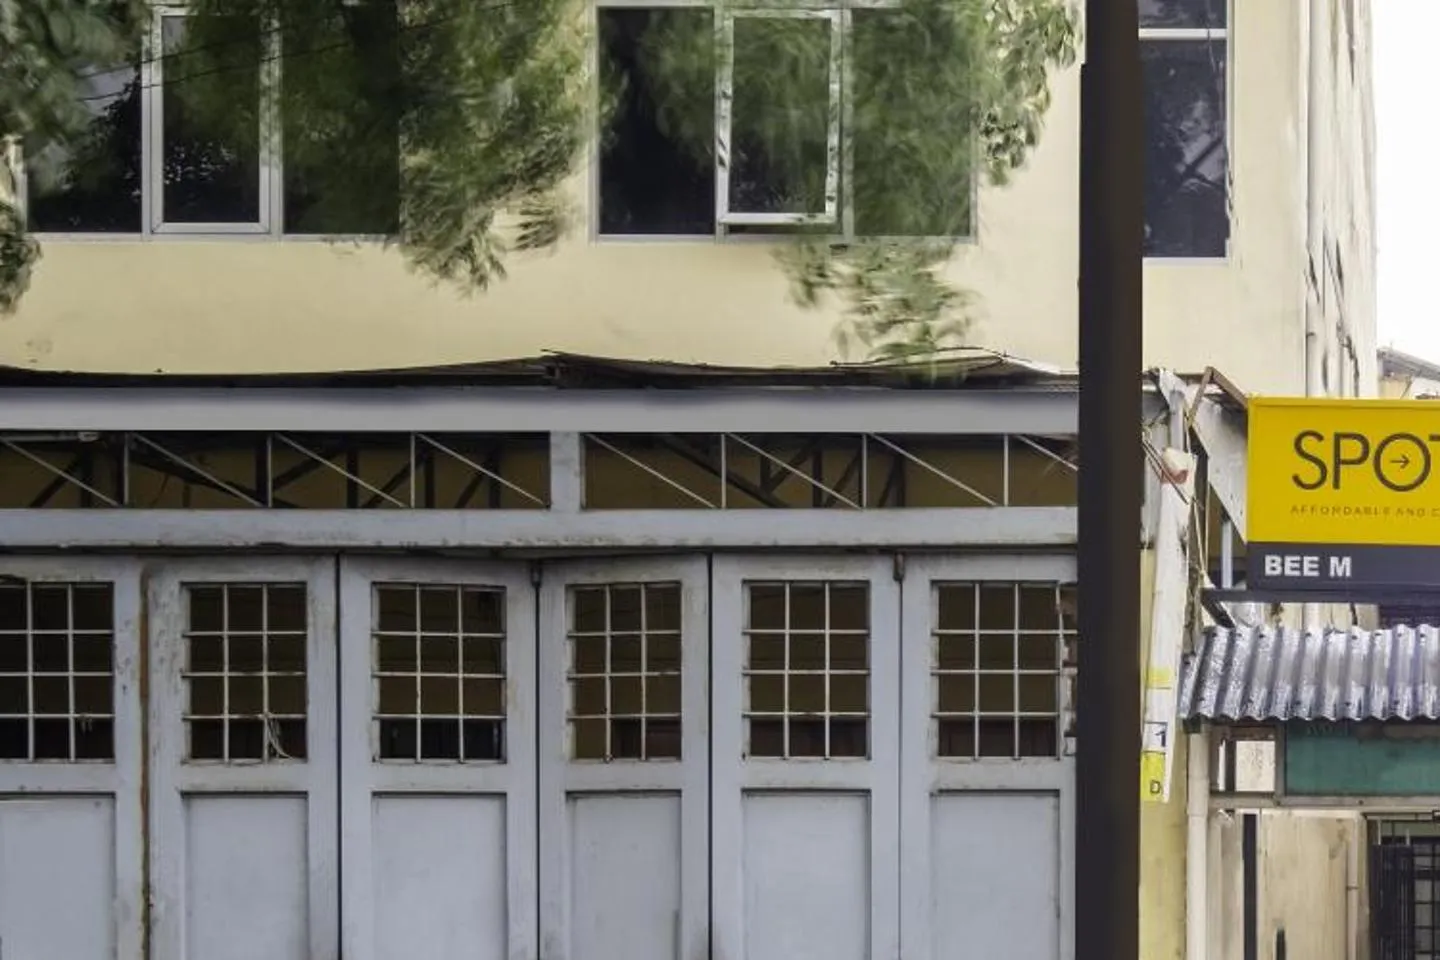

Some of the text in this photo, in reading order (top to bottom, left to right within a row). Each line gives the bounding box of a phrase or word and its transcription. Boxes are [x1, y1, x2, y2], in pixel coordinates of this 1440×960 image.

[1290, 504, 1390, 516] AFFORDABLE
[1264, 555, 1320, 577] BEE
[1329, 556, 1352, 578] M
